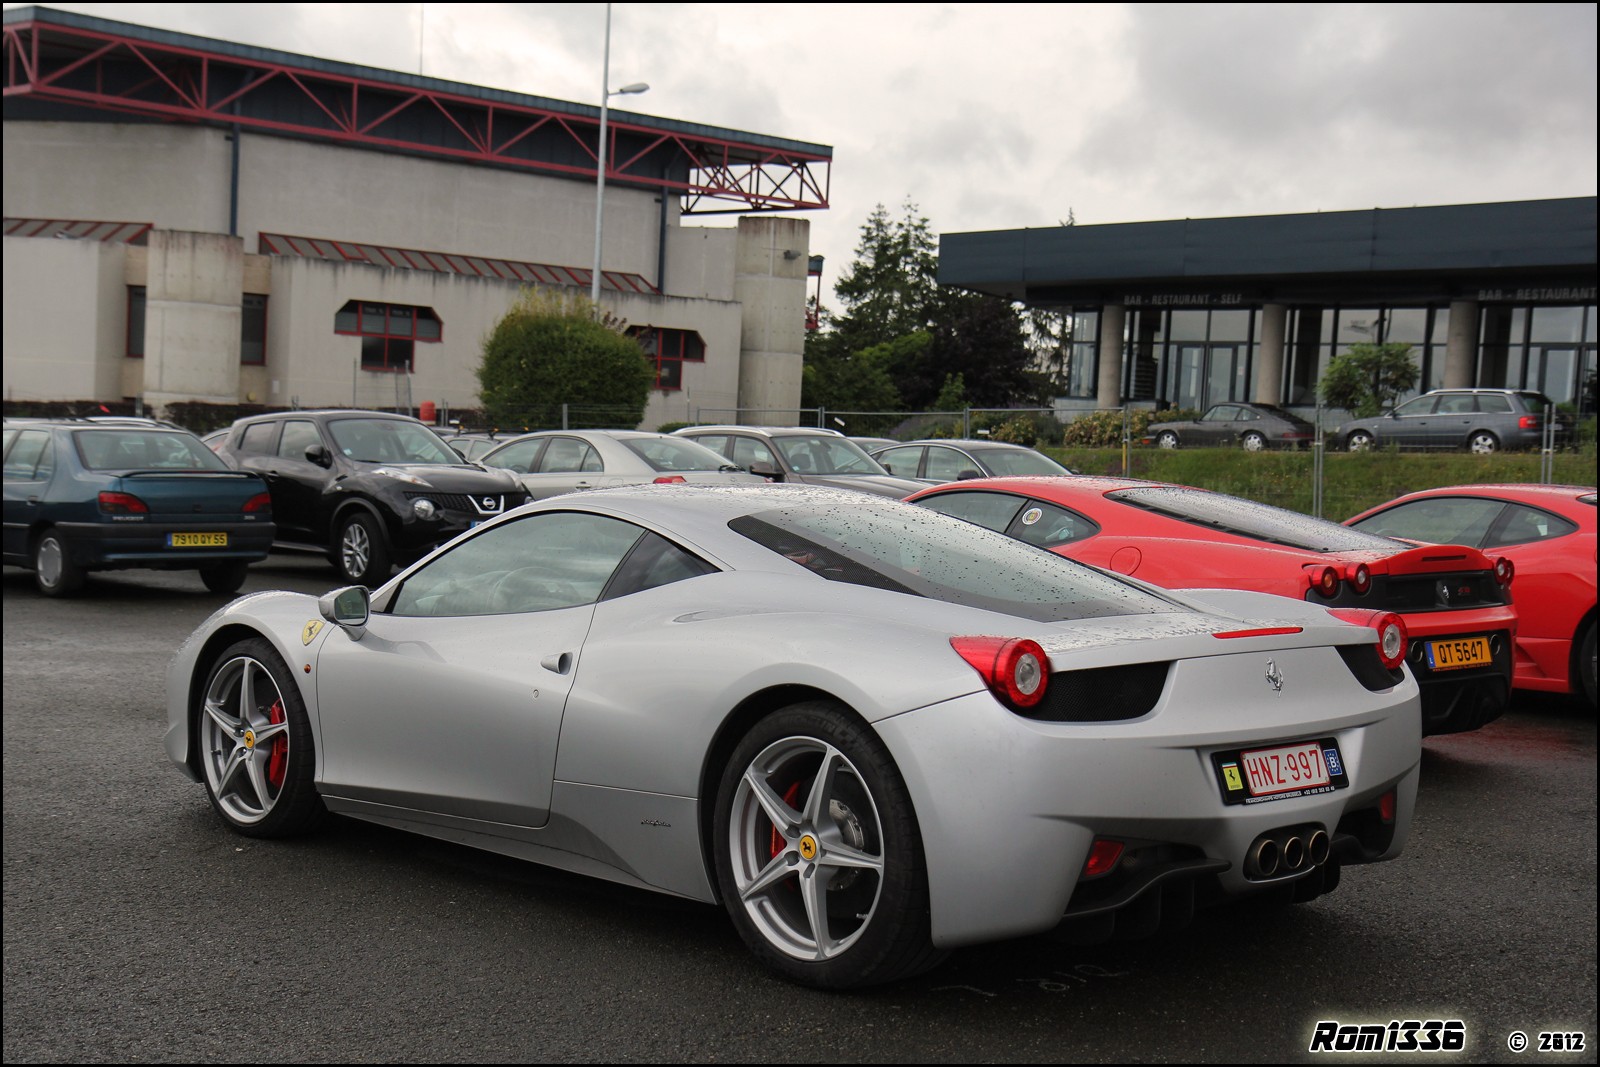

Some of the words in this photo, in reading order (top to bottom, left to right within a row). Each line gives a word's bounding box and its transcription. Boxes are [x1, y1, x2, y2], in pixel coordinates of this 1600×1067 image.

[1124, 295, 1142, 305] BAR
[1151, 294, 1210, 305] RESTAURANT
[1220, 293, 1243, 304] SELF
[1477, 289, 1503, 301] BAR
[1516, 287, 1597, 301] RESTAURANT
[174, 534, 199, 545] 7910
[200, 534, 212, 545] QY
[1438, 643, 1453, 664] QT
[1455, 641, 1484, 662] 5647
[1329, 757, 1336, 768] B
